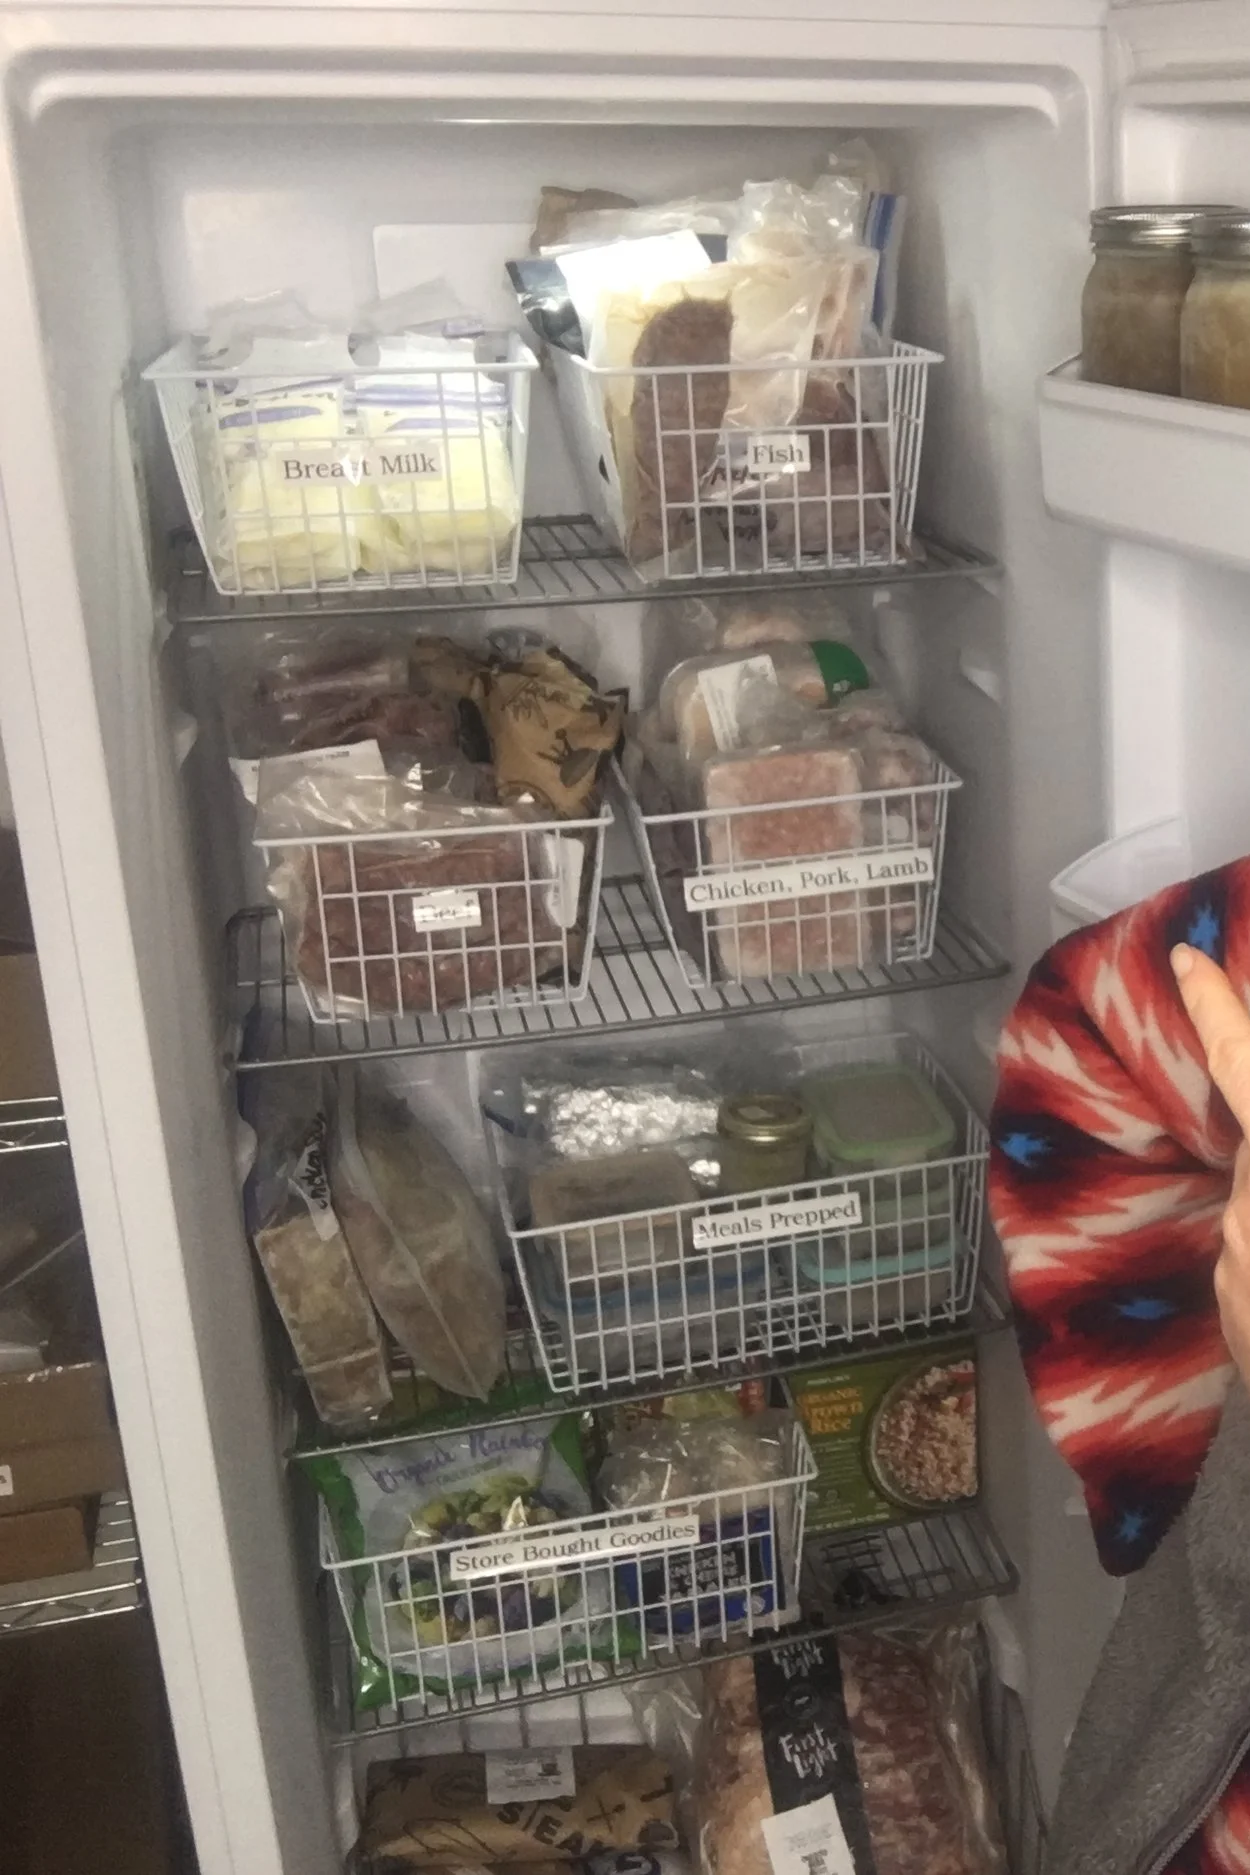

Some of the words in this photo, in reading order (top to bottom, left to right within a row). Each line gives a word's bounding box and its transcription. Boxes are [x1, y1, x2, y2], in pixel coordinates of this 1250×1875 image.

[379, 453, 438, 475] Milk
[753, 443, 804, 465] Fish
[689, 876, 793, 903] Chicken,
[800, 866, 860, 889] Pork,
[866, 856, 929, 880] Lamb
[698, 1216, 763, 1240] Meals
[769, 1200, 858, 1230] Prepped
[455, 1550, 515, 1573] Store
[522, 1536, 601, 1563] Bought
[609, 1522, 697, 1549] Goodies
